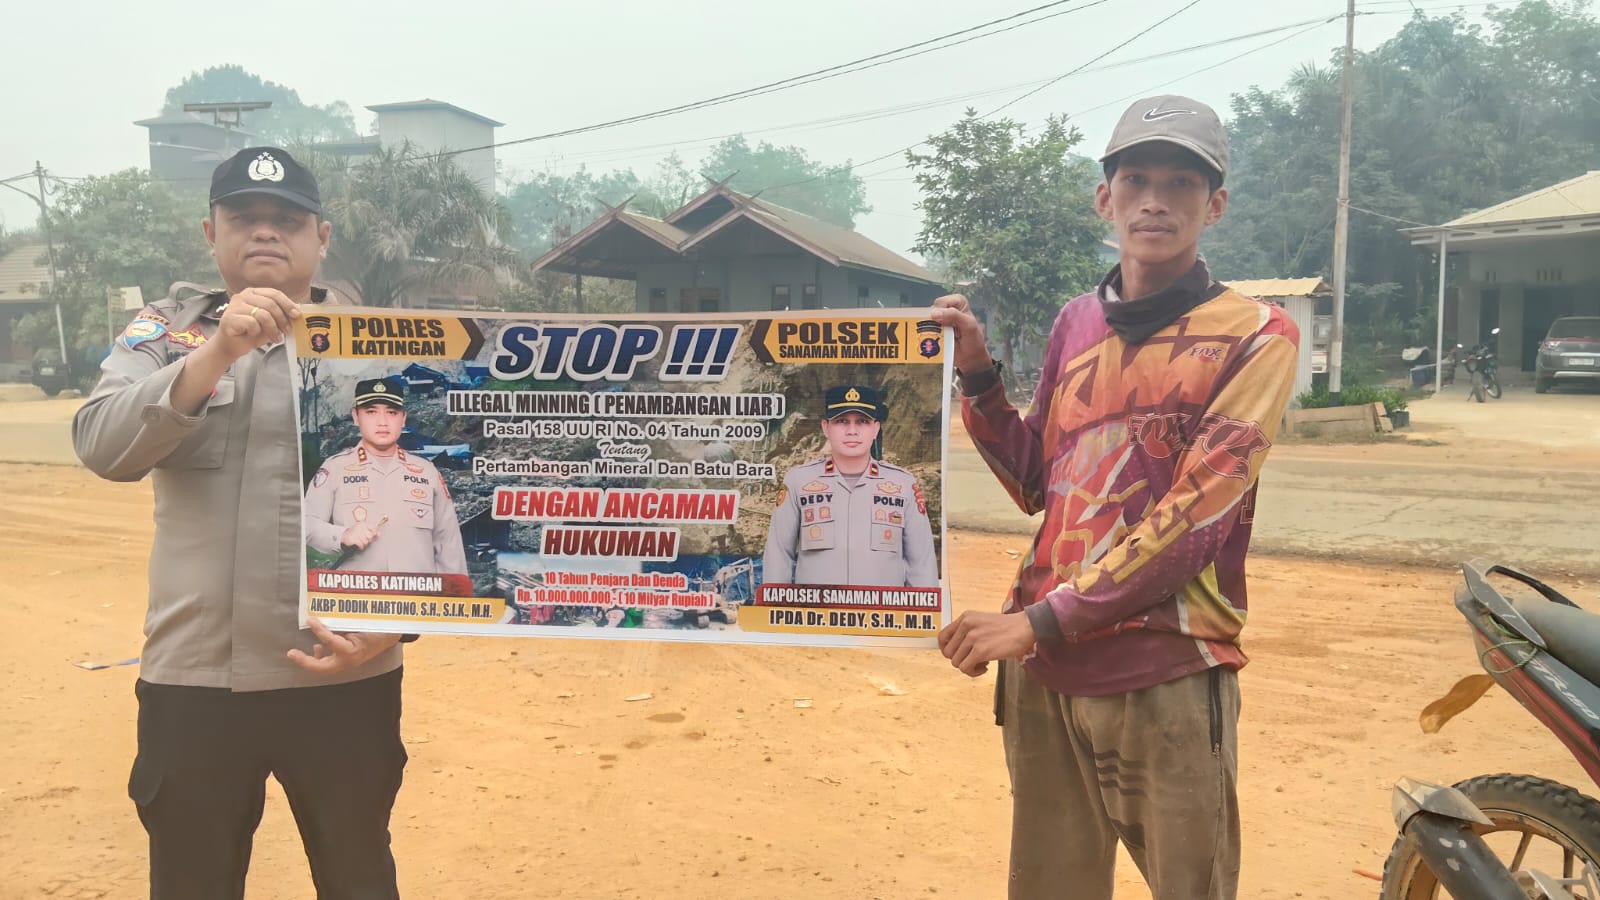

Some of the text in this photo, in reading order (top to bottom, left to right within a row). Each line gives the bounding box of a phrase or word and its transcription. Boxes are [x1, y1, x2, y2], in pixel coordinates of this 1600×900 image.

[351, 317, 445, 338] POLRES
[778, 321, 900, 345] POLSEK
[351, 340, 446, 356] KATINGAN
[495, 326, 739, 375] STOP !!!
[779, 345, 899, 359] SANAMAN MANTIKEI
[450, 393, 512, 413] ILLEGAL
[515, 394, 590, 414] MINNING
[605, 396, 731, 415] PENAMBANGAN
[736, 396, 772, 416] LIAR
[486, 422, 762, 438] Pasal 158 UU RI No. 04 Tahun 2009
[600, 441, 649, 458] Tentang
[475, 460, 773, 476] Pertambangan Mineral Dan Batu Bara
[343, 475, 369, 484] DODIK
[403, 475, 429, 485] POLRI
[495, 491, 736, 521] DENGAN ANCAMAN
[800, 494, 833, 506] DEDY
[873, 495, 904, 508] POLRI
[543, 529, 676, 558] HUKUMAN
[318, 573, 442, 592] KAPOLRES KATINGAN
[545, 572, 685, 588] 10 Tahun Penjara Dan Denda
[517, 589, 533, 602] Rp.
[624, 593, 635, 605] 10
[637, 593, 669, 607] Milyar
[671, 594, 707, 607] Rupiah
[763, 587, 938, 607] KAPOLSEK SANAMAN MANTIKEI
[311, 598, 336, 612] AKBP
[338, 600, 368, 614] DODIK
[471, 604, 492, 618] M.H.
[770, 610, 936, 630] IPDA Dr. DEDY, S.H., M.H.
